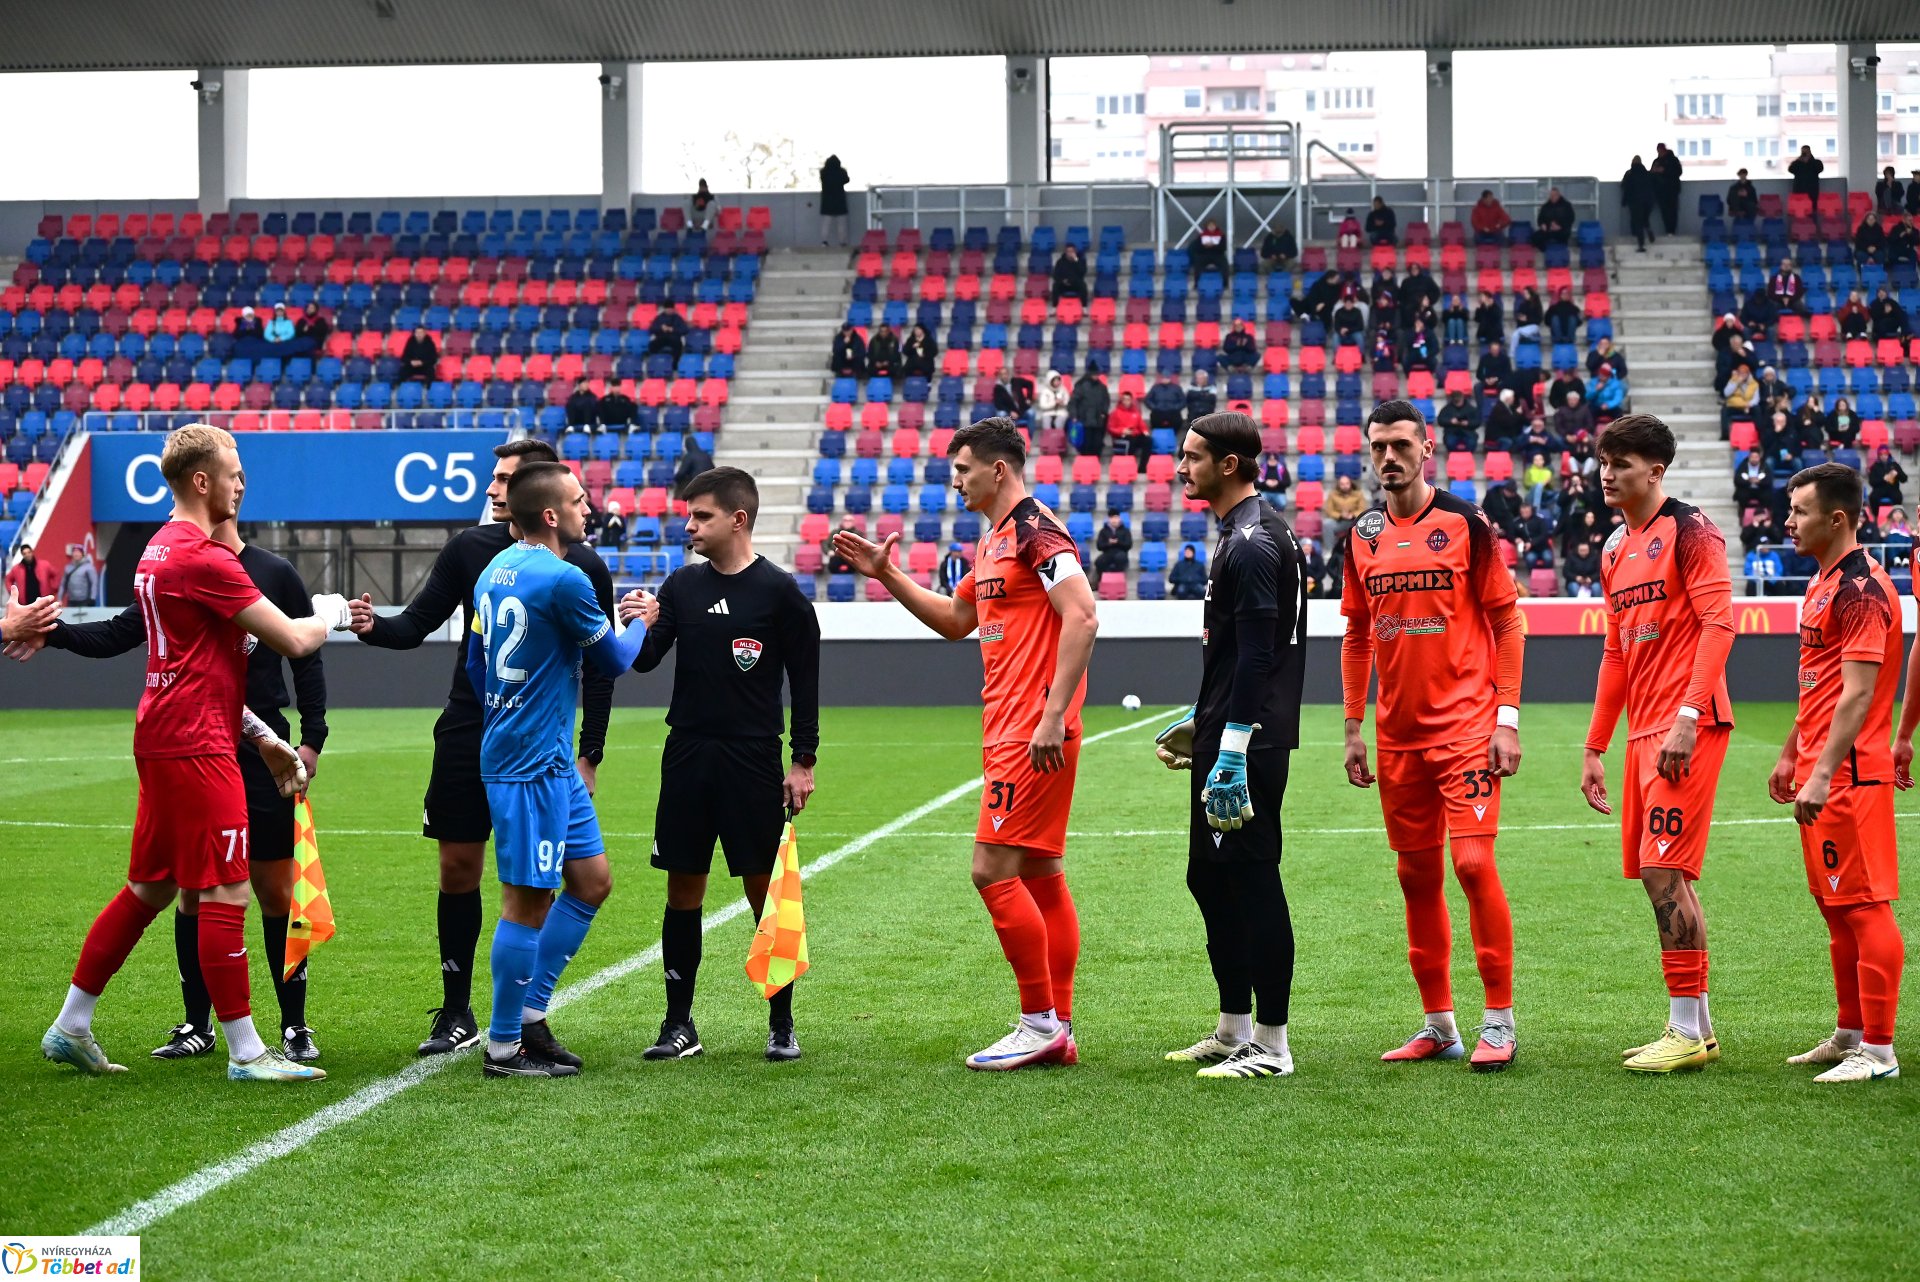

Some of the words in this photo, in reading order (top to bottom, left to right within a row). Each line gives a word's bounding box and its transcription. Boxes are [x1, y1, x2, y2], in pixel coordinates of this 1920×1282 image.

[124, 453, 170, 504] C
[394, 452, 477, 503] C5
[479, 592, 529, 684] 92
[739, 641, 757, 649] MLSZ
[988, 781, 1016, 812] 31
[1463, 770, 1493, 799] 33
[1649, 806, 1684, 836] 66
[221, 827, 247, 862] 71
[538, 839, 566, 872] 92
[1822, 840, 1839, 869] 6
